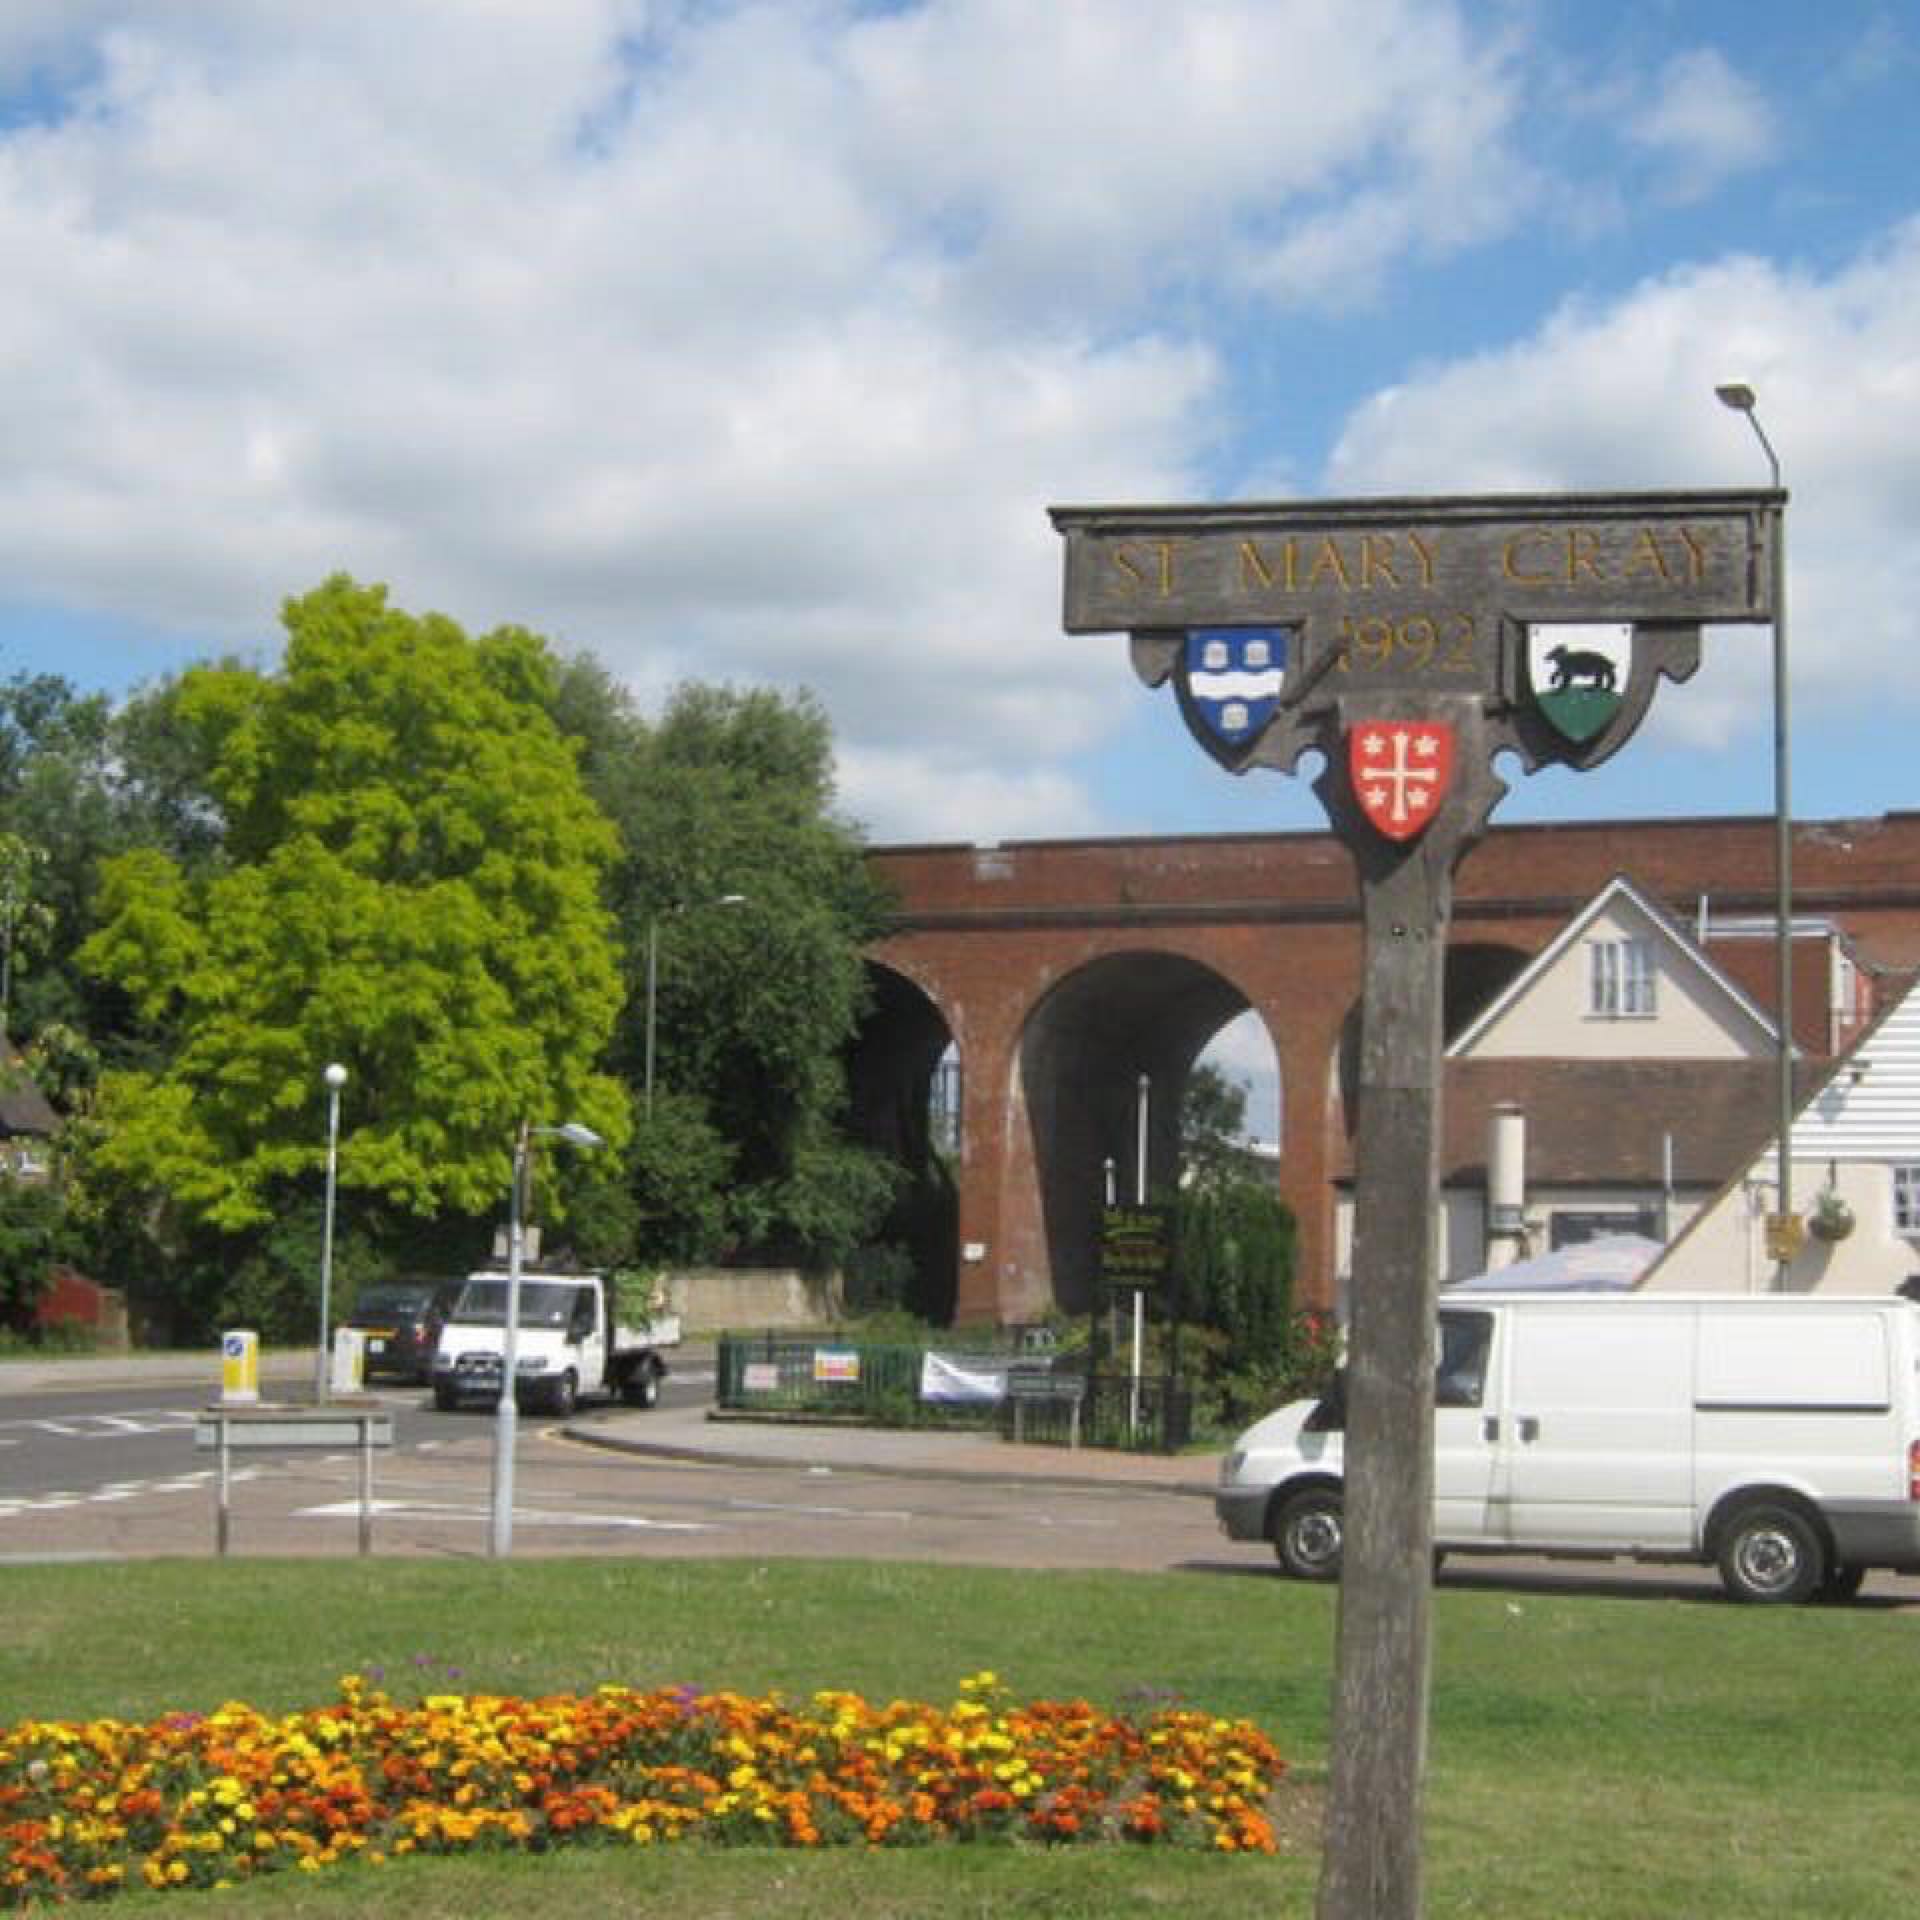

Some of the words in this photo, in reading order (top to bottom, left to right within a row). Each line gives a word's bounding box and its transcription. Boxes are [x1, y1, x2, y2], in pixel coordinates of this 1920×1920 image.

[1110, 541, 1190, 597] ST
[1236, 530, 1442, 592] MARY
[1502, 524, 1720, 586] CRAY
[1337, 611, 1477, 673] 1992
